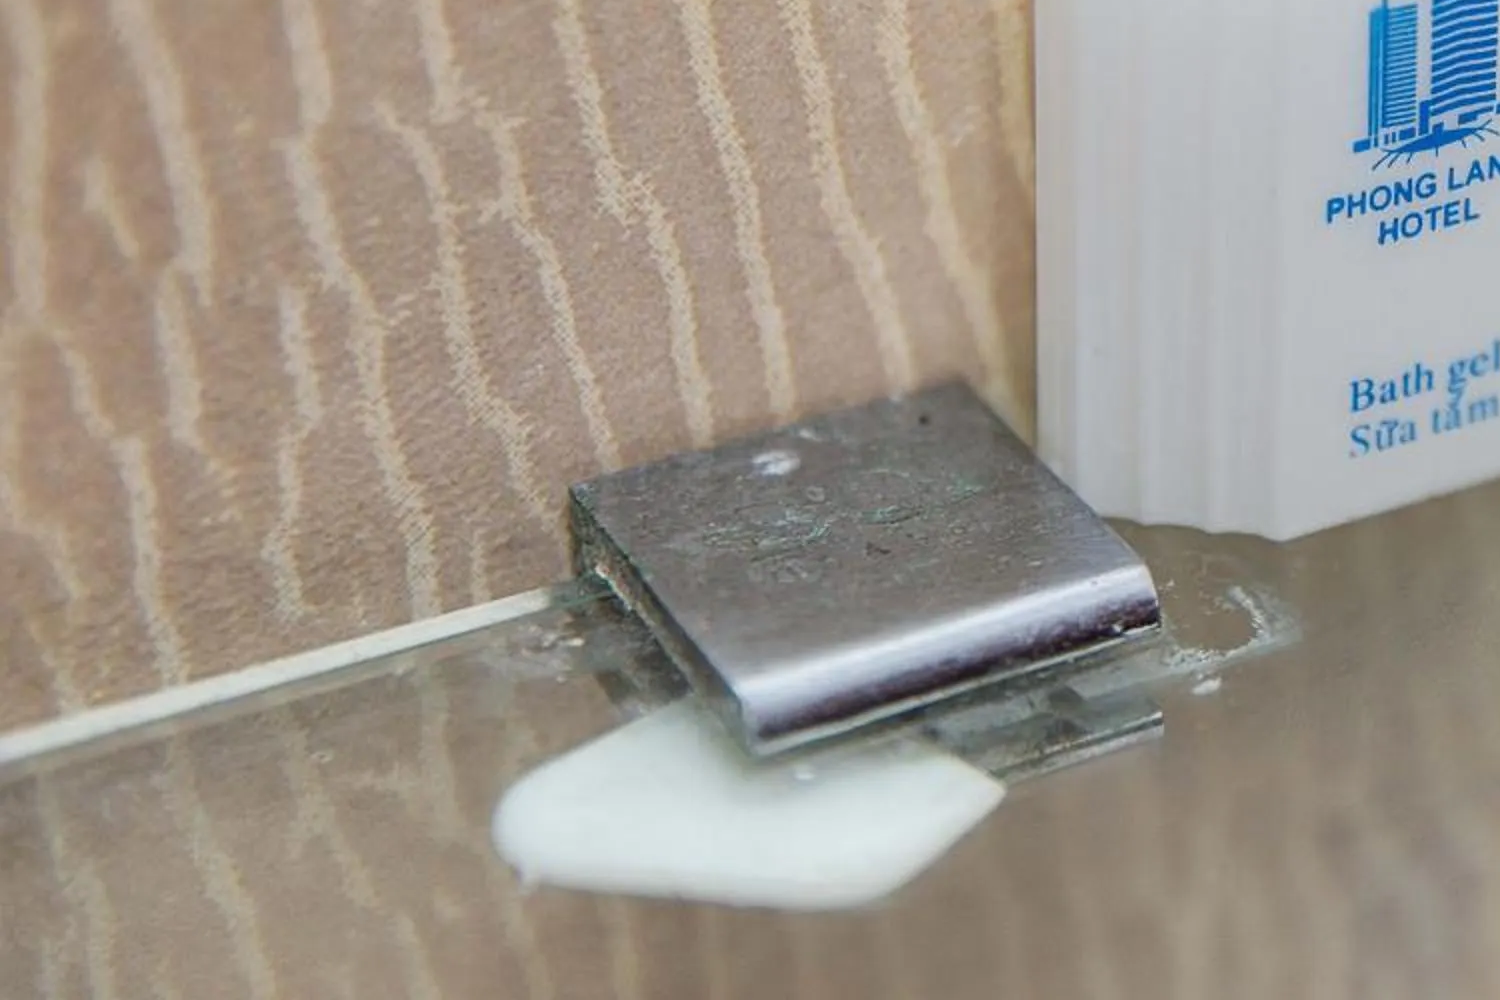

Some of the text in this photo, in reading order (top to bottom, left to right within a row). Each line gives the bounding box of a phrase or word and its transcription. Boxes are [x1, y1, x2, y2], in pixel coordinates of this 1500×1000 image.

[1326, 173, 1437, 223] PHONG
[1377, 198, 1480, 245] HOTEL
[1349, 362, 1434, 412] Bath
[1348, 419, 1417, 458] Sữa
